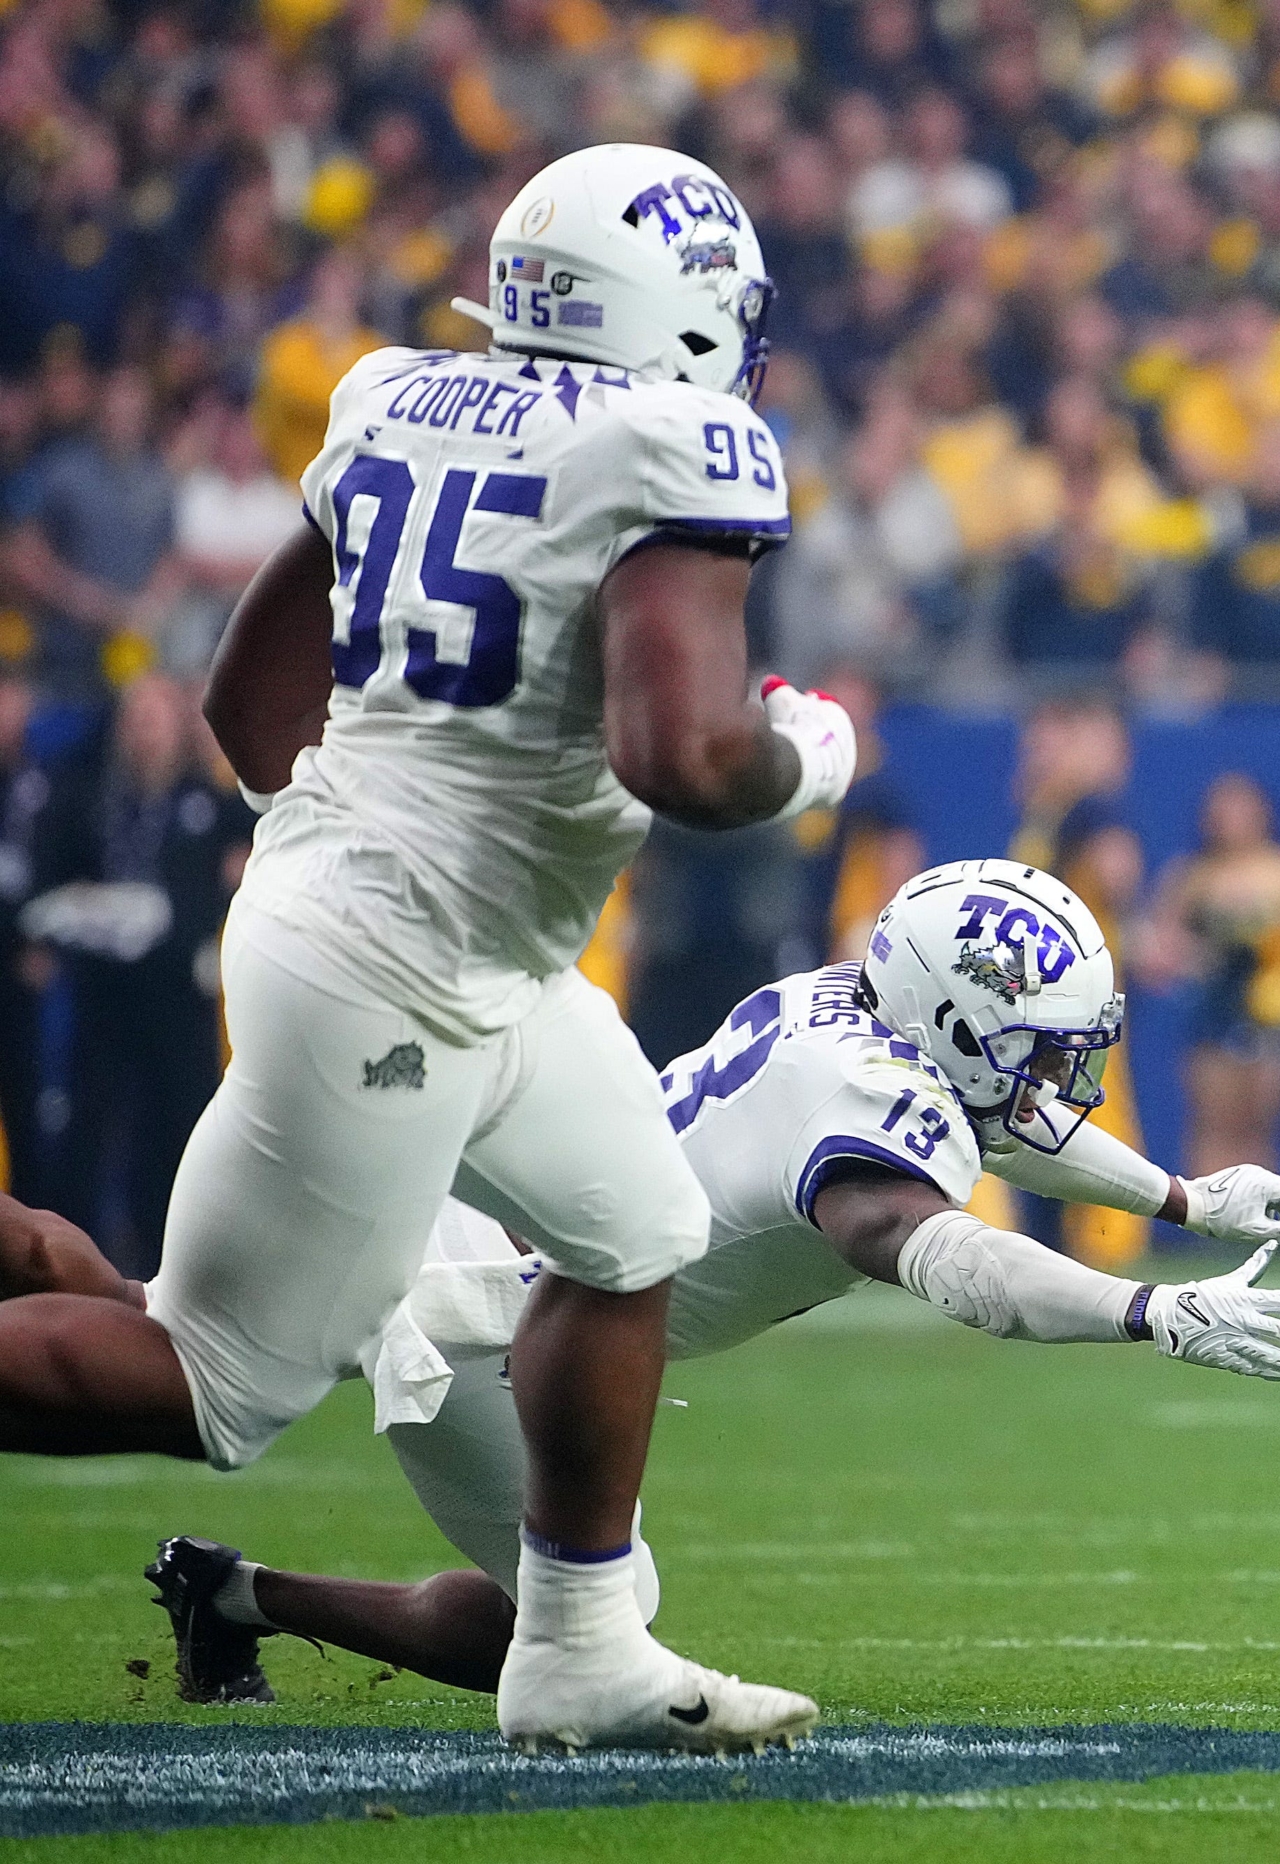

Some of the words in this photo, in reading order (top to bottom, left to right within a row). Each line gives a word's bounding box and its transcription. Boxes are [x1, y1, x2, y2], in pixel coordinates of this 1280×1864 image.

[504, 285, 551, 328] 95
[387, 375, 543, 438] COOPER
[702, 422, 776, 492] 95
[331, 454, 548, 708] 95
[954, 894, 1076, 984] TCU
[878, 1089, 950, 1161] 13
